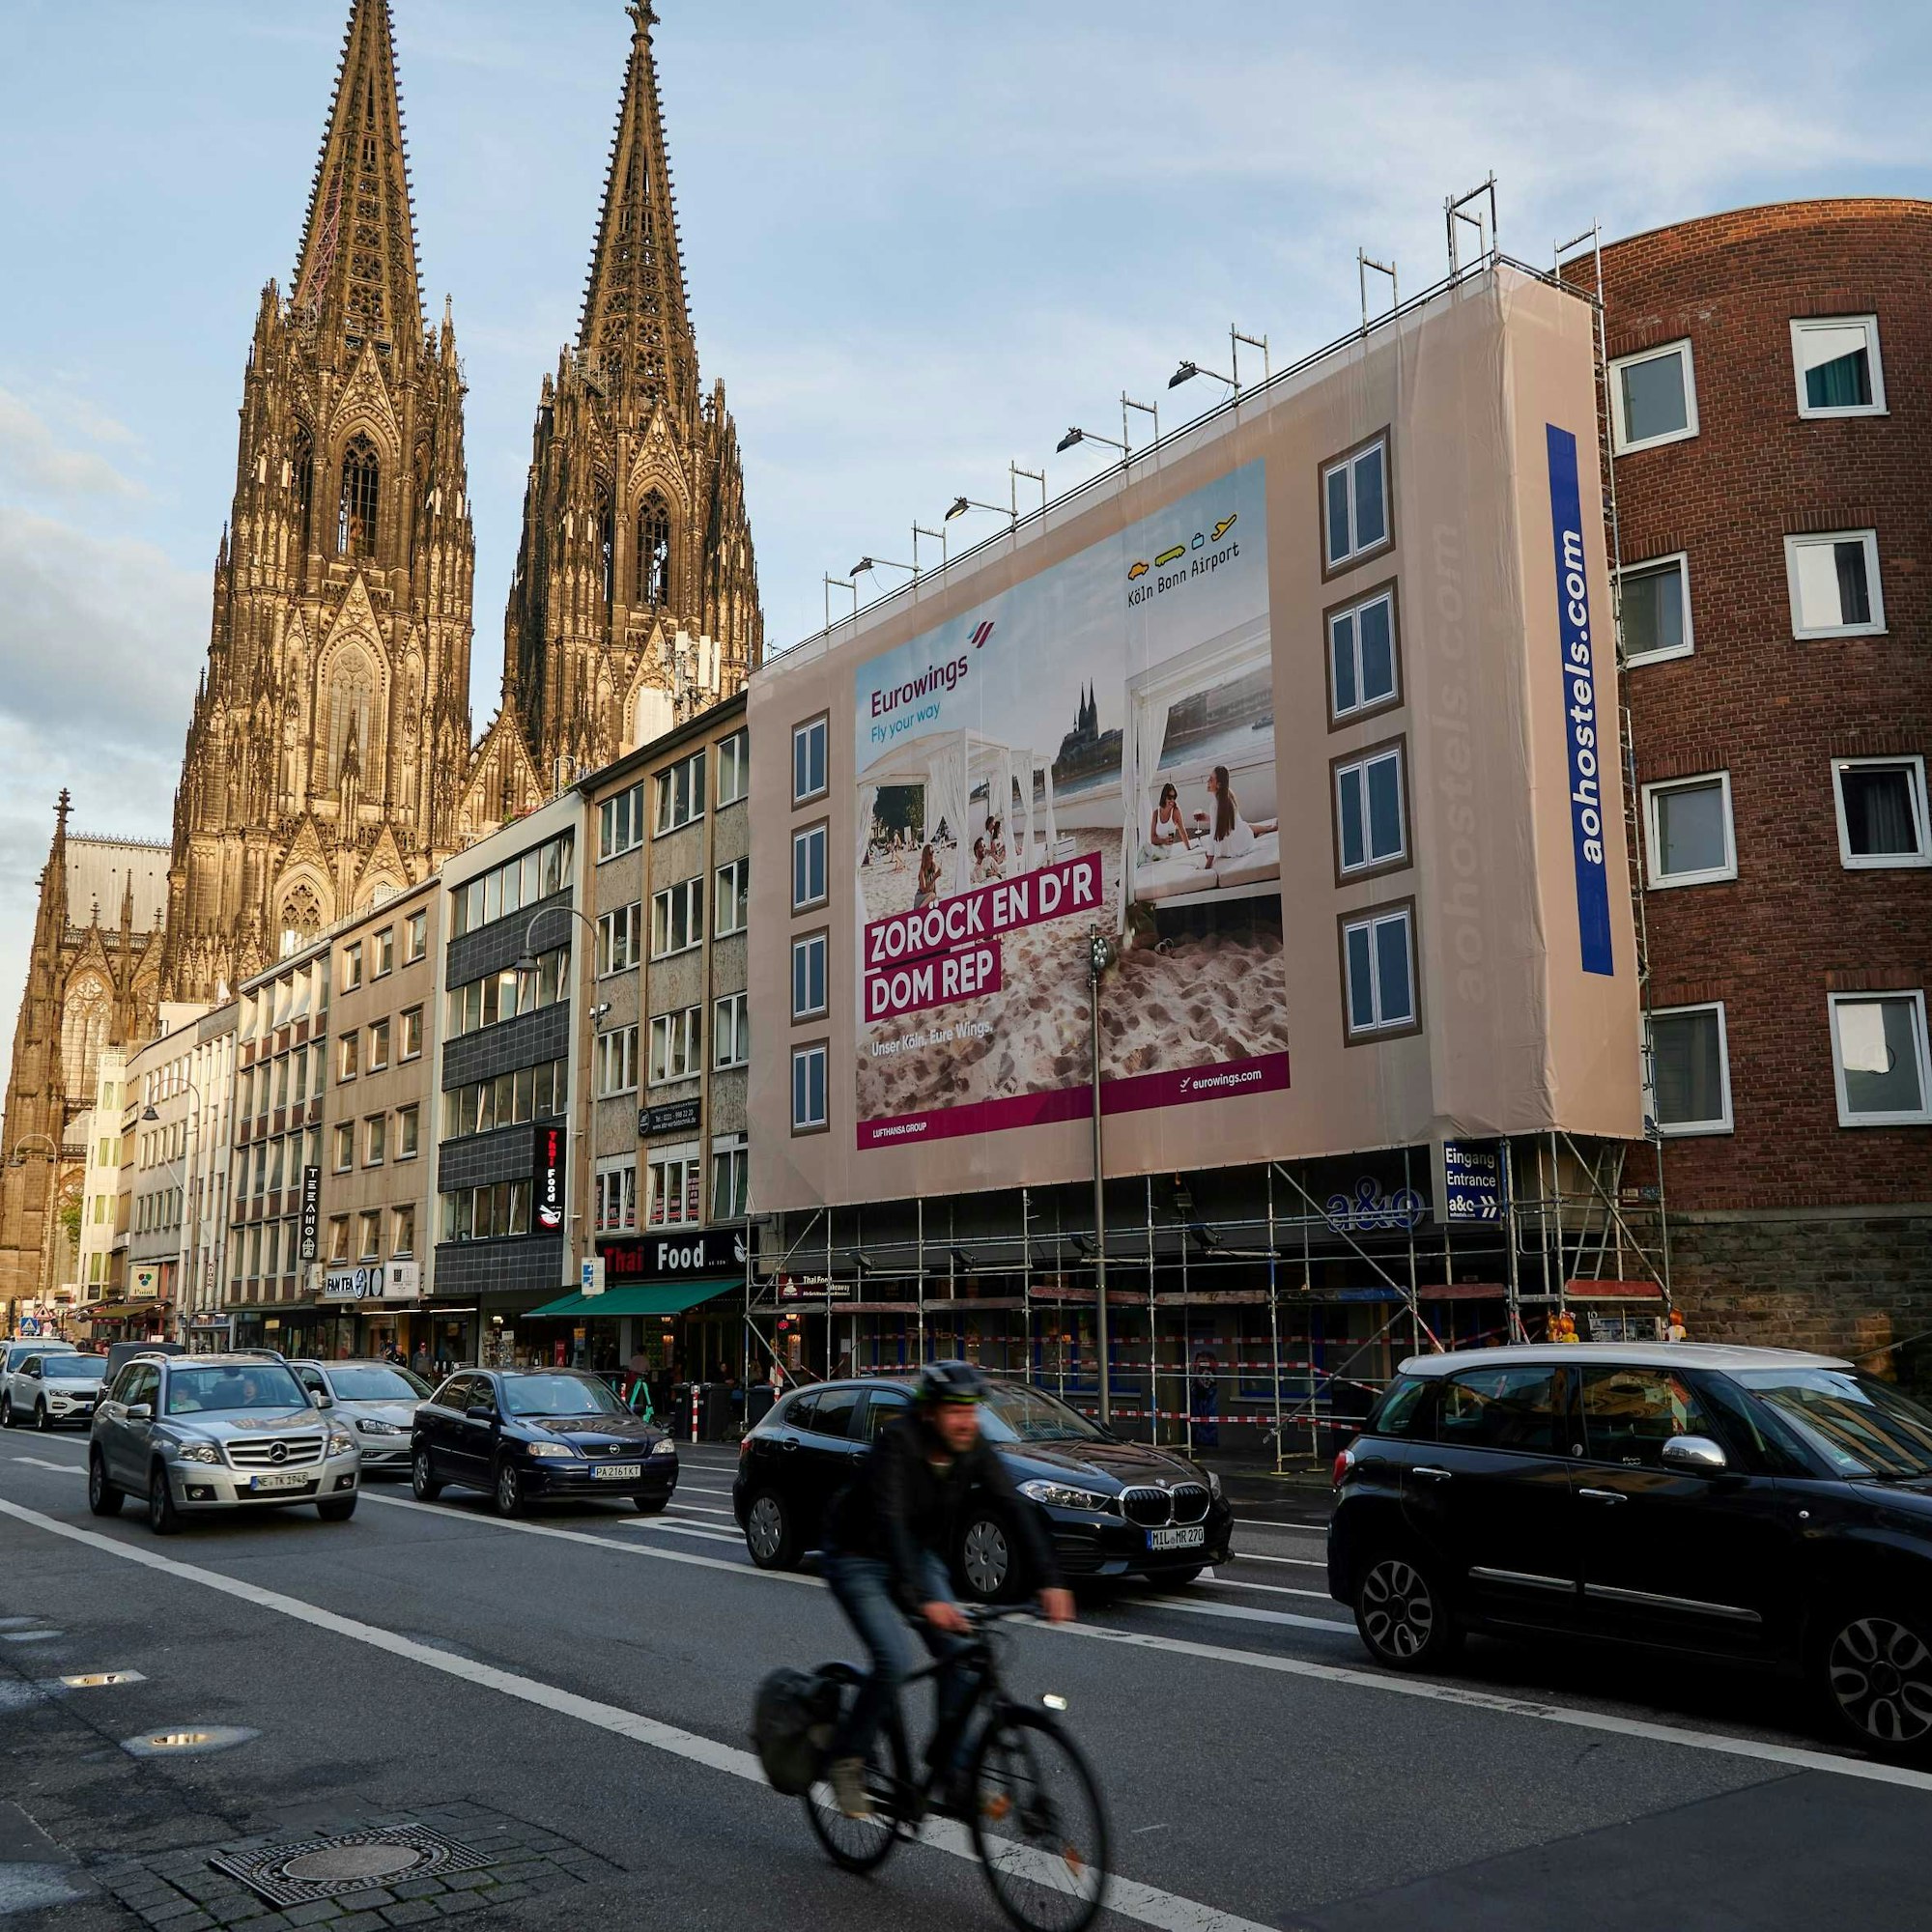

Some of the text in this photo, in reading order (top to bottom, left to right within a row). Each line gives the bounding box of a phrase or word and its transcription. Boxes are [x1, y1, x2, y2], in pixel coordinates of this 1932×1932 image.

[1128, 541, 1239, 608] Köln Bonn Airport
[871, 655, 968, 718] Eurowings
[1562, 529, 1602, 865] aohostels.com
[871, 701, 941, 742] Fly your way
[871, 895, 984, 963] ZORÖCK
[992, 880, 1029, 927] EN
[871, 949, 994, 1015] DOM REP
[871, 1020, 993, 1057] Unser Köln. Eure Wings.
[1192, 1069, 1262, 1090] eurowings.com
[872, 1122, 927, 1138] LUFTHANSA GROUP
[548, 1131, 557, 1167] Thai
[1445, 1148, 1494, 1169] Eingang
[547, 1169, 555, 1202] Food
[1446, 1170, 1496, 1187] Entrance
[1326, 1176, 1424, 1233] a&o
[604, 1240, 704, 1273] Thai Food
[803, 1276, 816, 1285] Thai
[1153, 1528, 1203, 1546] MIL MR 270
